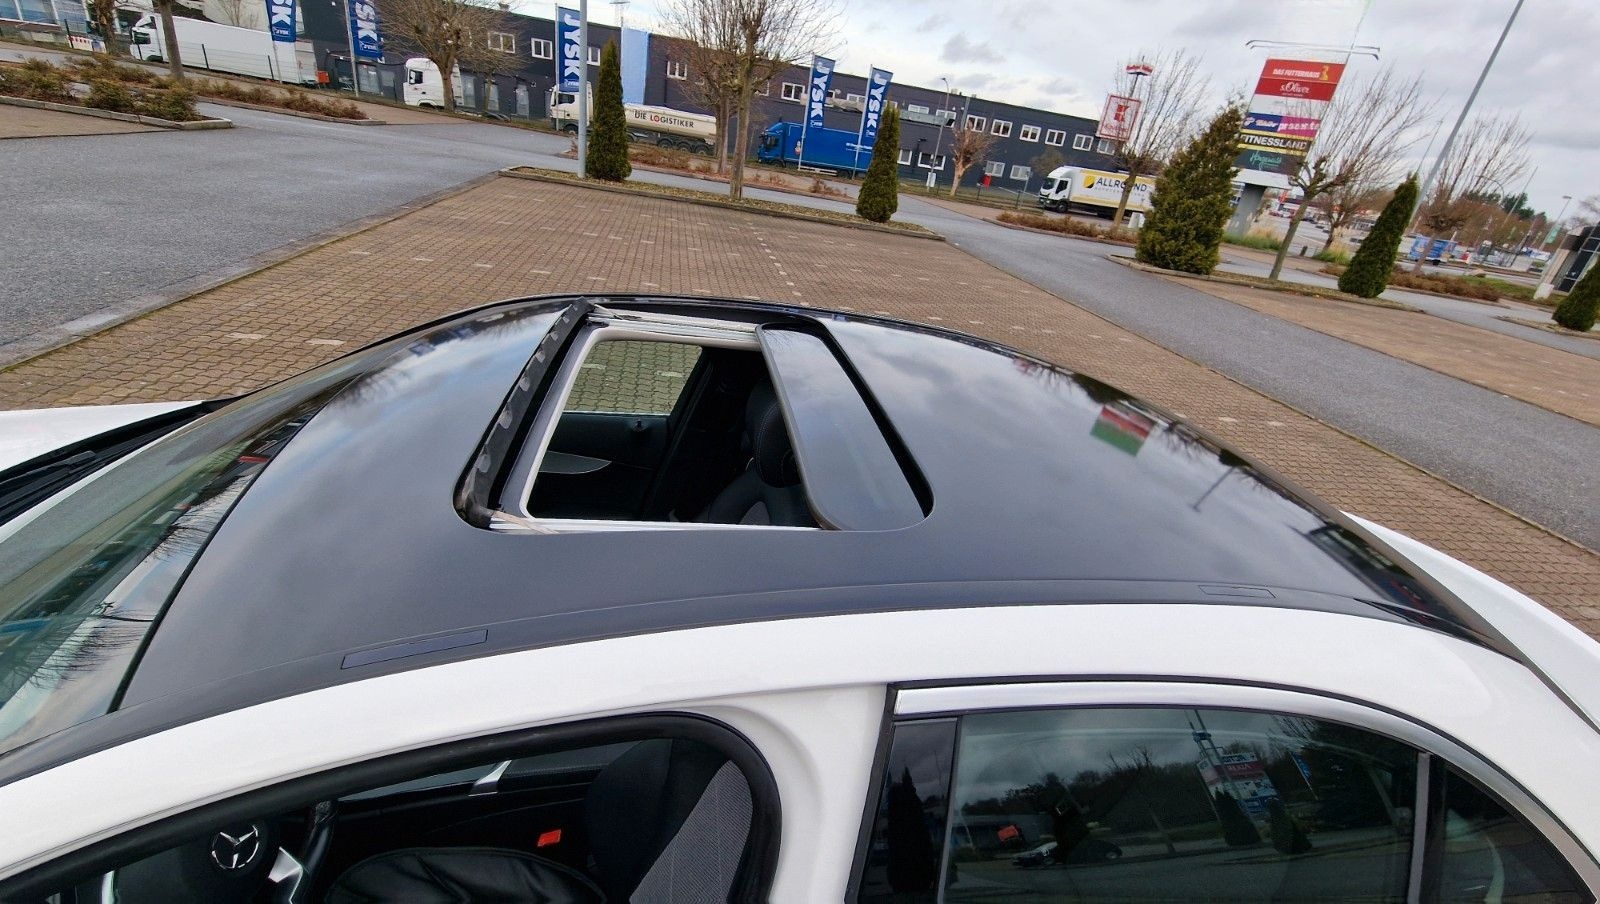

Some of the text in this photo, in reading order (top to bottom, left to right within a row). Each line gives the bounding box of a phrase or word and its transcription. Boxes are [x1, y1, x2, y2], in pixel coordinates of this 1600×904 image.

[564, 13, 580, 78] JYSK
[811, 61, 830, 119] JYSK
[867, 73, 887, 130] JYSK
[634, 110, 694, 128] DIE LOGISTIKER
[1096, 177, 1147, 192] ALLROND
